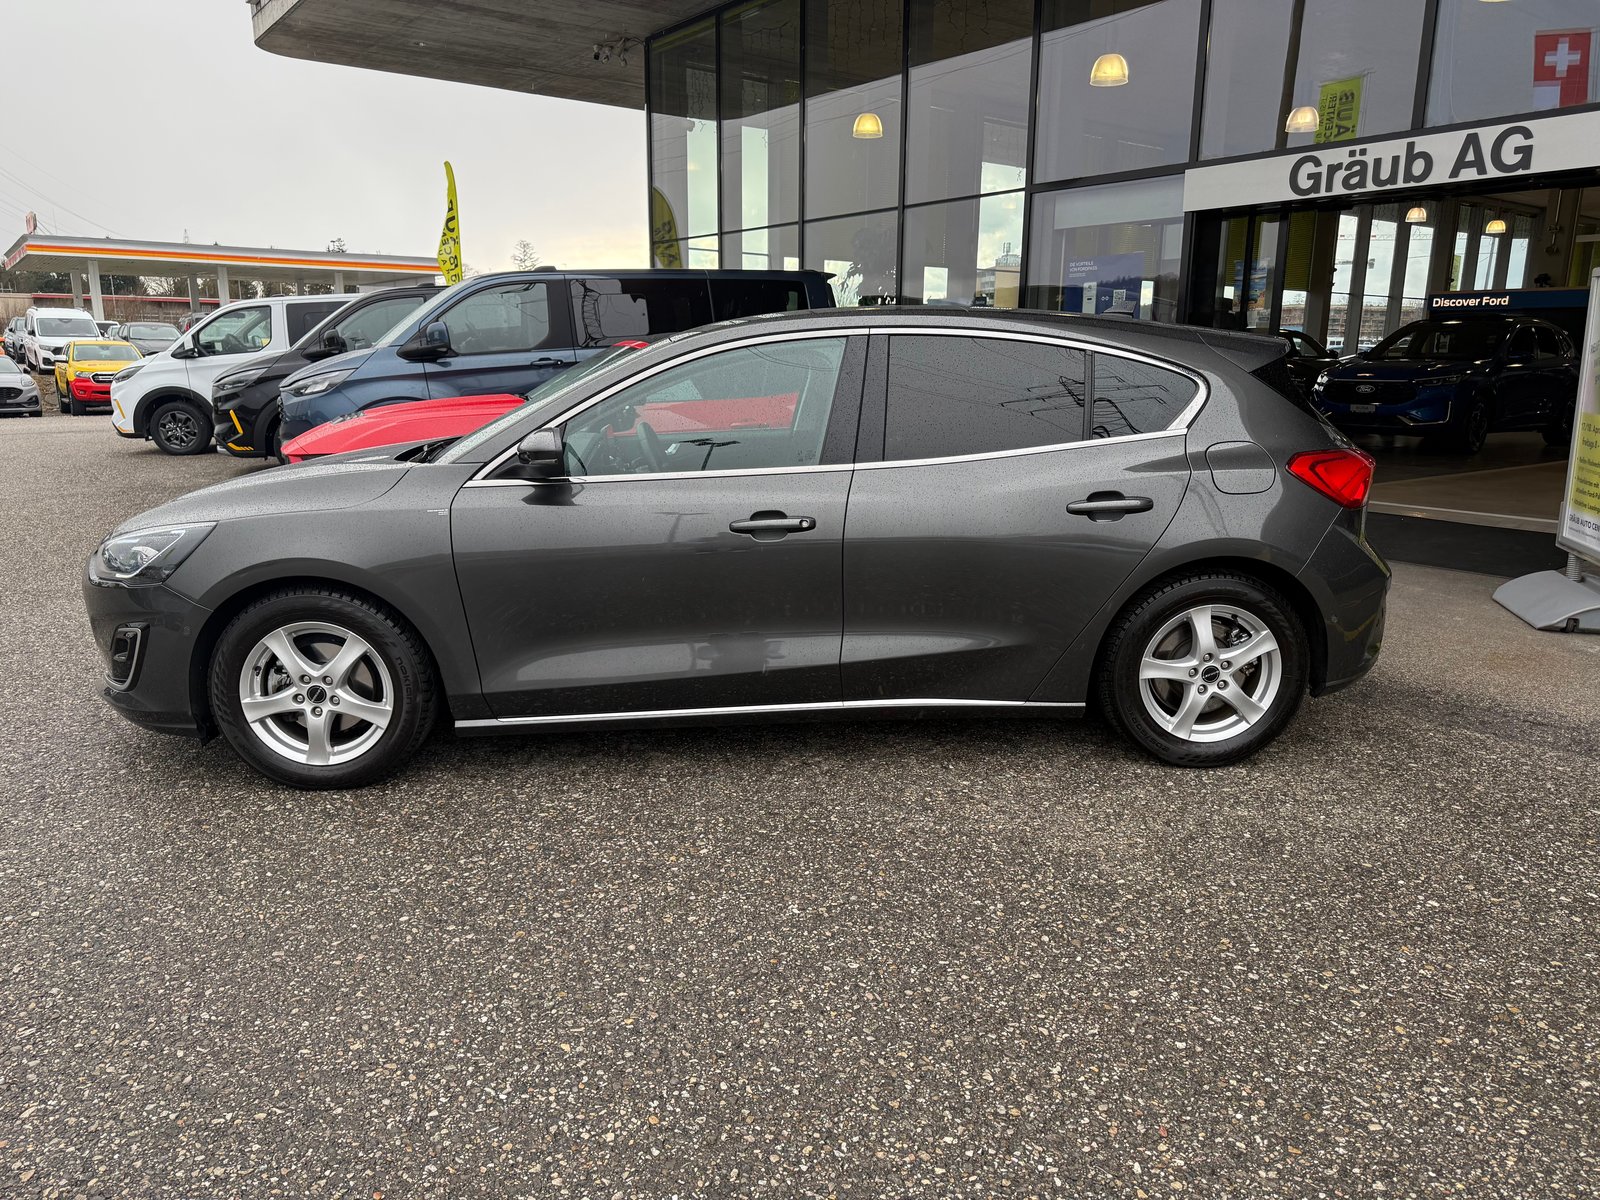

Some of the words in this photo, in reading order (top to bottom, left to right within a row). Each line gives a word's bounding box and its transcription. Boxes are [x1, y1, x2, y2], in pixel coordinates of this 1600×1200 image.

[1288, 141, 1434, 197] Gräub
[1448, 125, 1535, 179] AG
[1432, 297, 1480, 307] Discover
[1482, 295, 1510, 306] Ford
